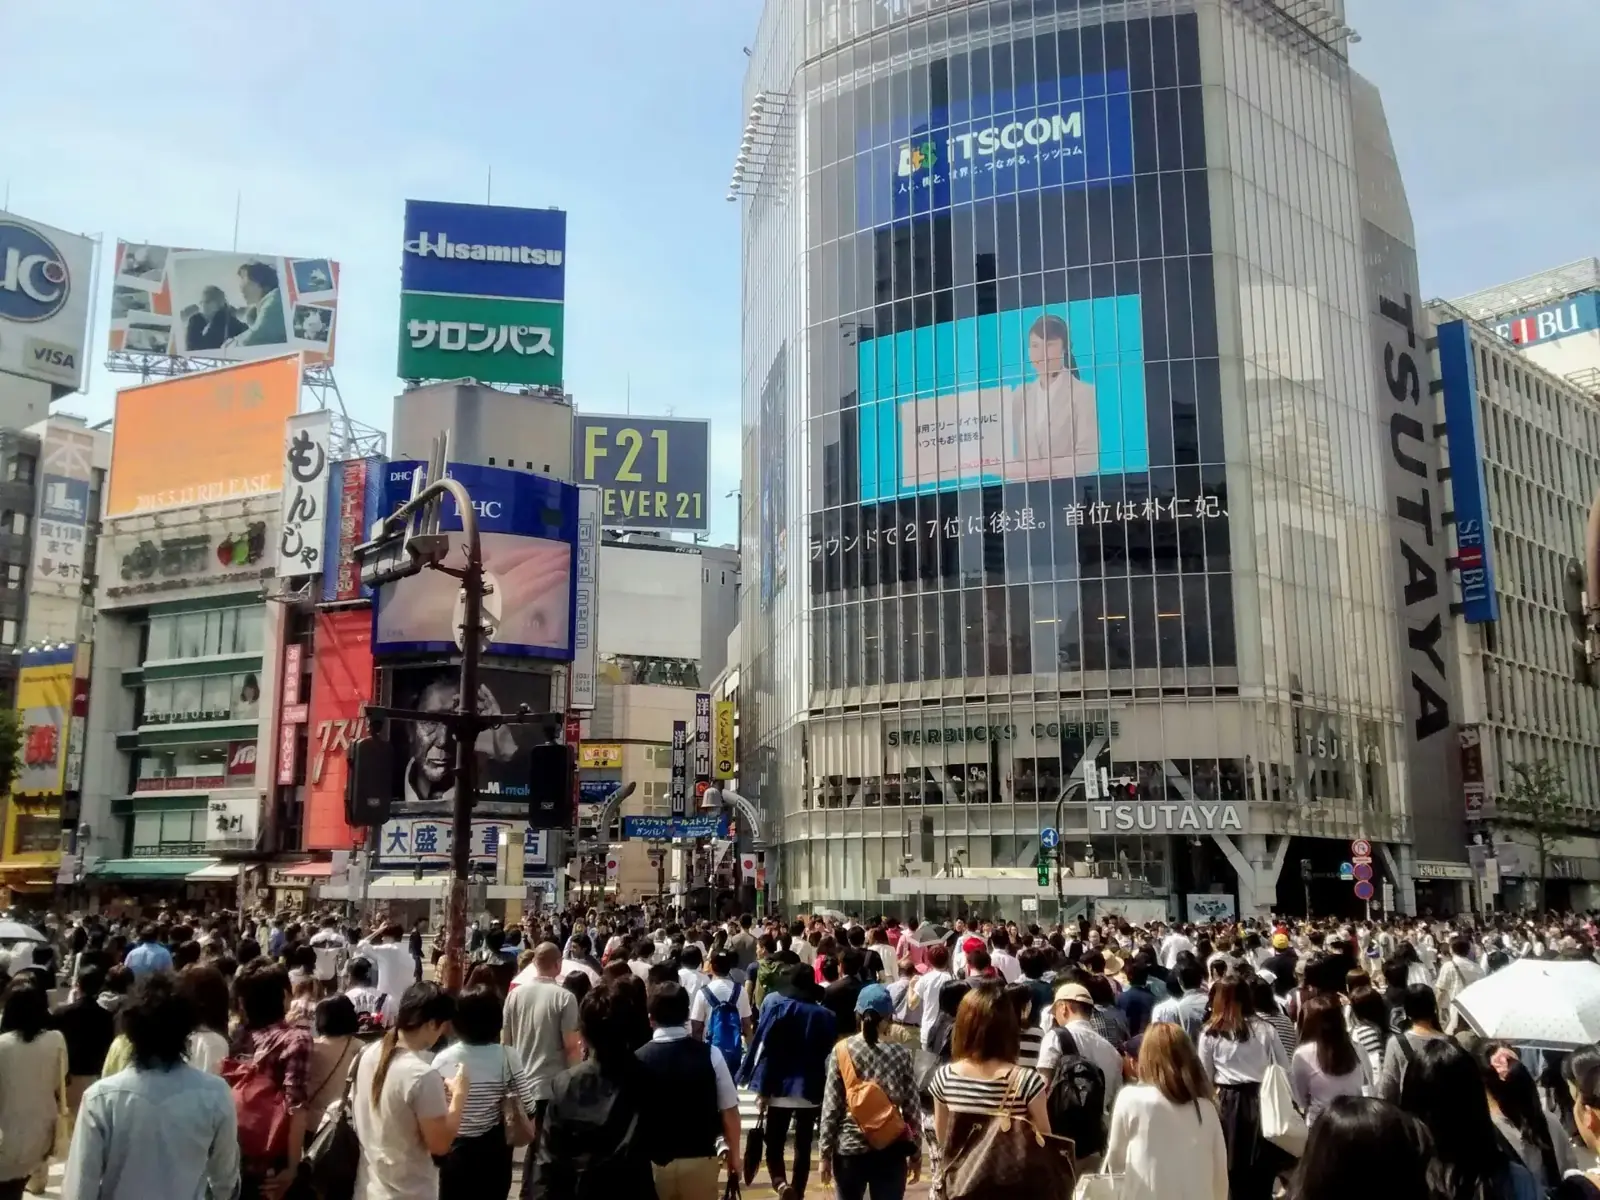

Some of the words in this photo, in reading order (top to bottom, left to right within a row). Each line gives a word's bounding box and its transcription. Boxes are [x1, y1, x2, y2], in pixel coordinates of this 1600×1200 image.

[403, 231, 562, 266] Hisamitsu
[407, 319, 555, 357] サロンパス
[1489, 303, 1580, 343] EIBU
[34, 347, 75, 369] VISA
[198, 473, 272, 501] RELEASE
[390, 471, 412, 482] DHC
[281, 430, 325, 570] もんじゃ
[676, 492, 701, 519] 21
[1380, 293, 1450, 741] TSUTAYA
[1459, 519, 1486, 602] SEIBU
[147, 706, 226, 724] Euphoria
[696, 698, 709, 775] 洋服の青山
[888, 723, 1018, 747] STARBUCKS
[1030, 720, 1120, 740] COFFEE
[1305, 734, 1383, 767] TSUTAYA
[673, 730, 685, 813] 洋服の青山
[720, 762, 731, 771] 4F
[631, 817, 722, 826] バスケットボールストリート
[1093, 805, 1242, 830] TSUTAYA
